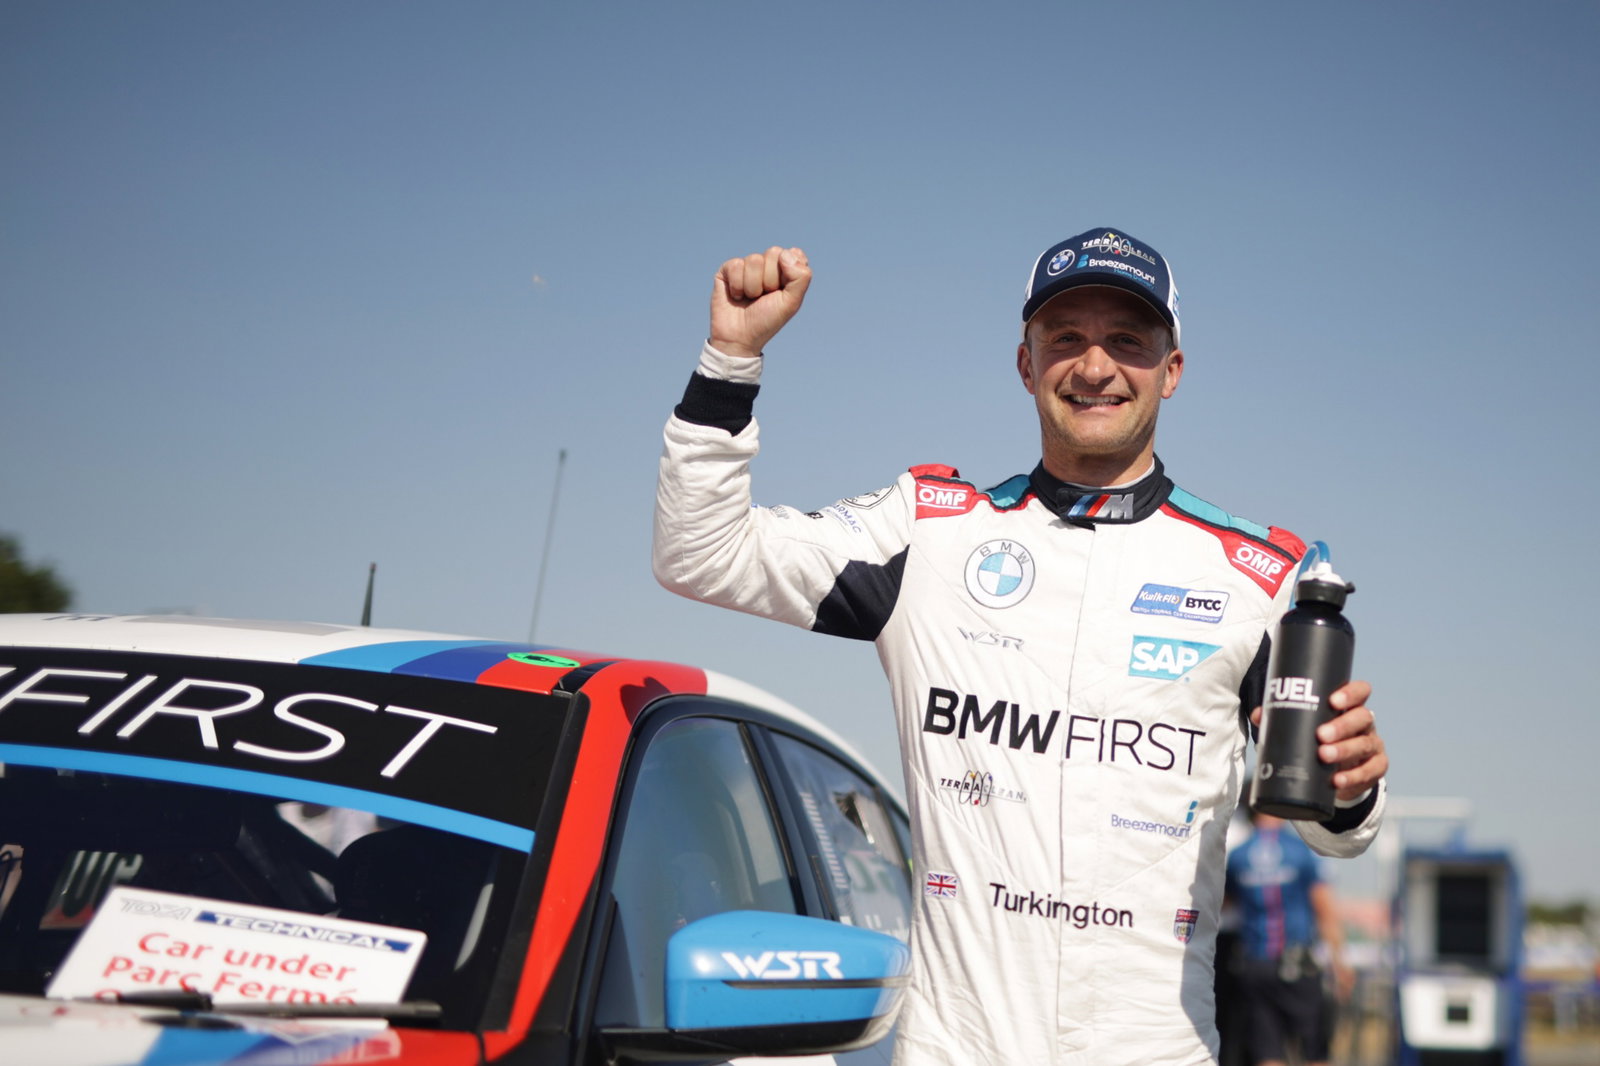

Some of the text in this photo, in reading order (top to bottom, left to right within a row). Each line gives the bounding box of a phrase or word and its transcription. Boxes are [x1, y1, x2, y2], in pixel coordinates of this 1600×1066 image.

[1089, 258, 1156, 285] Breezemount
[918, 487, 967, 507] OMP
[1236, 546, 1282, 576] OMP
[1138, 591, 1162, 602] Kwik
[1185, 597, 1221, 611] BTCC
[957, 626, 1025, 651] WSR
[1131, 640, 1199, 675] SAP
[1268, 677, 1320, 703] FUEL
[0, 667, 498, 778] FIRST
[922, 686, 1206, 775] BMW FIRST
[1111, 813, 1191, 837] Breezemount
[989, 882, 1133, 929] Turkington
[212, 912, 395, 952] TECHNICAL
[138, 931, 357, 983] Car under
[721, 952, 844, 979] WSR
[102, 955, 204, 992] Parc
